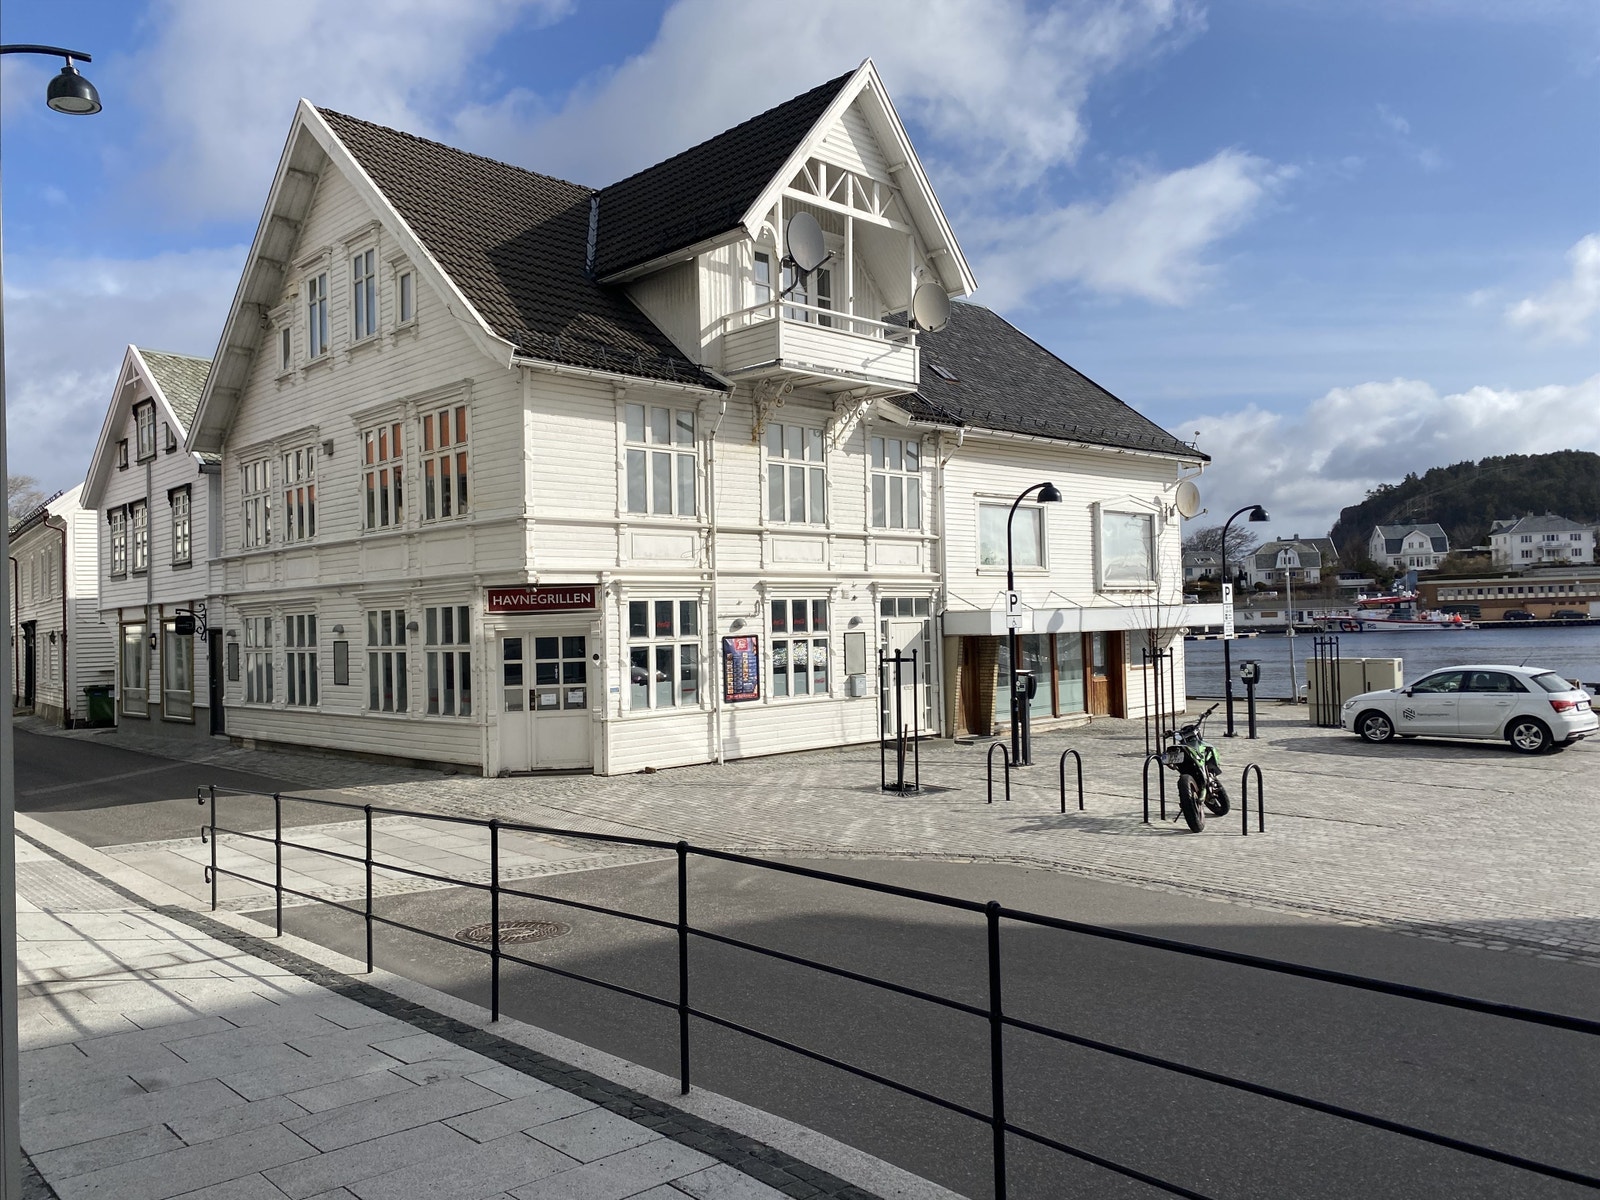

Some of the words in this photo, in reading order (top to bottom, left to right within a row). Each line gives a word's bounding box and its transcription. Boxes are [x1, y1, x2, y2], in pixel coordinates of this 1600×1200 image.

[493, 593, 591, 606] HAVNEGRILLEN
[1225, 586, 1230, 601] P
[1010, 594, 1018, 612] P
